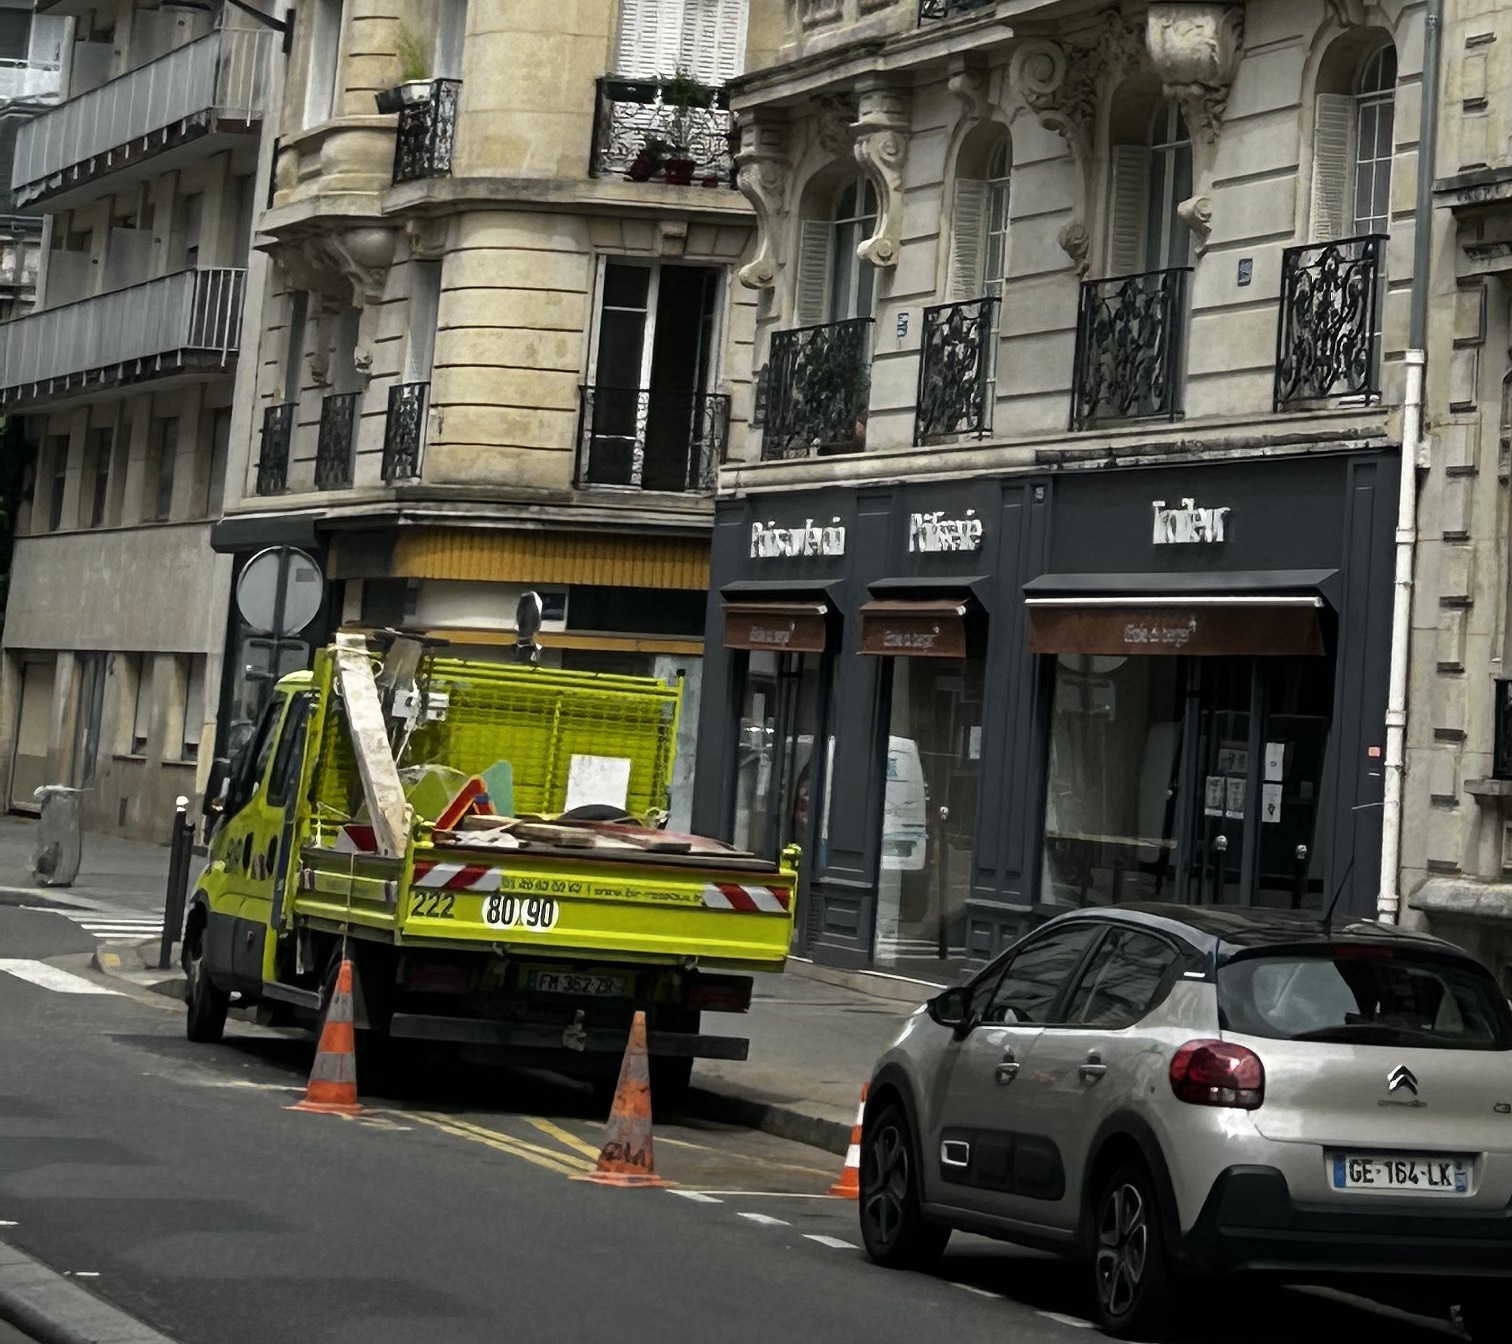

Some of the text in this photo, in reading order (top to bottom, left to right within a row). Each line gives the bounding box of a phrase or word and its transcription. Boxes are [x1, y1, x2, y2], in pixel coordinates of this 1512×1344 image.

[410, 891, 456, 919] 222
[486, 894, 516, 926] 80
[526, 898, 555, 928] 90
[1349, 1158, 1453, 1187] GE-164-LK
